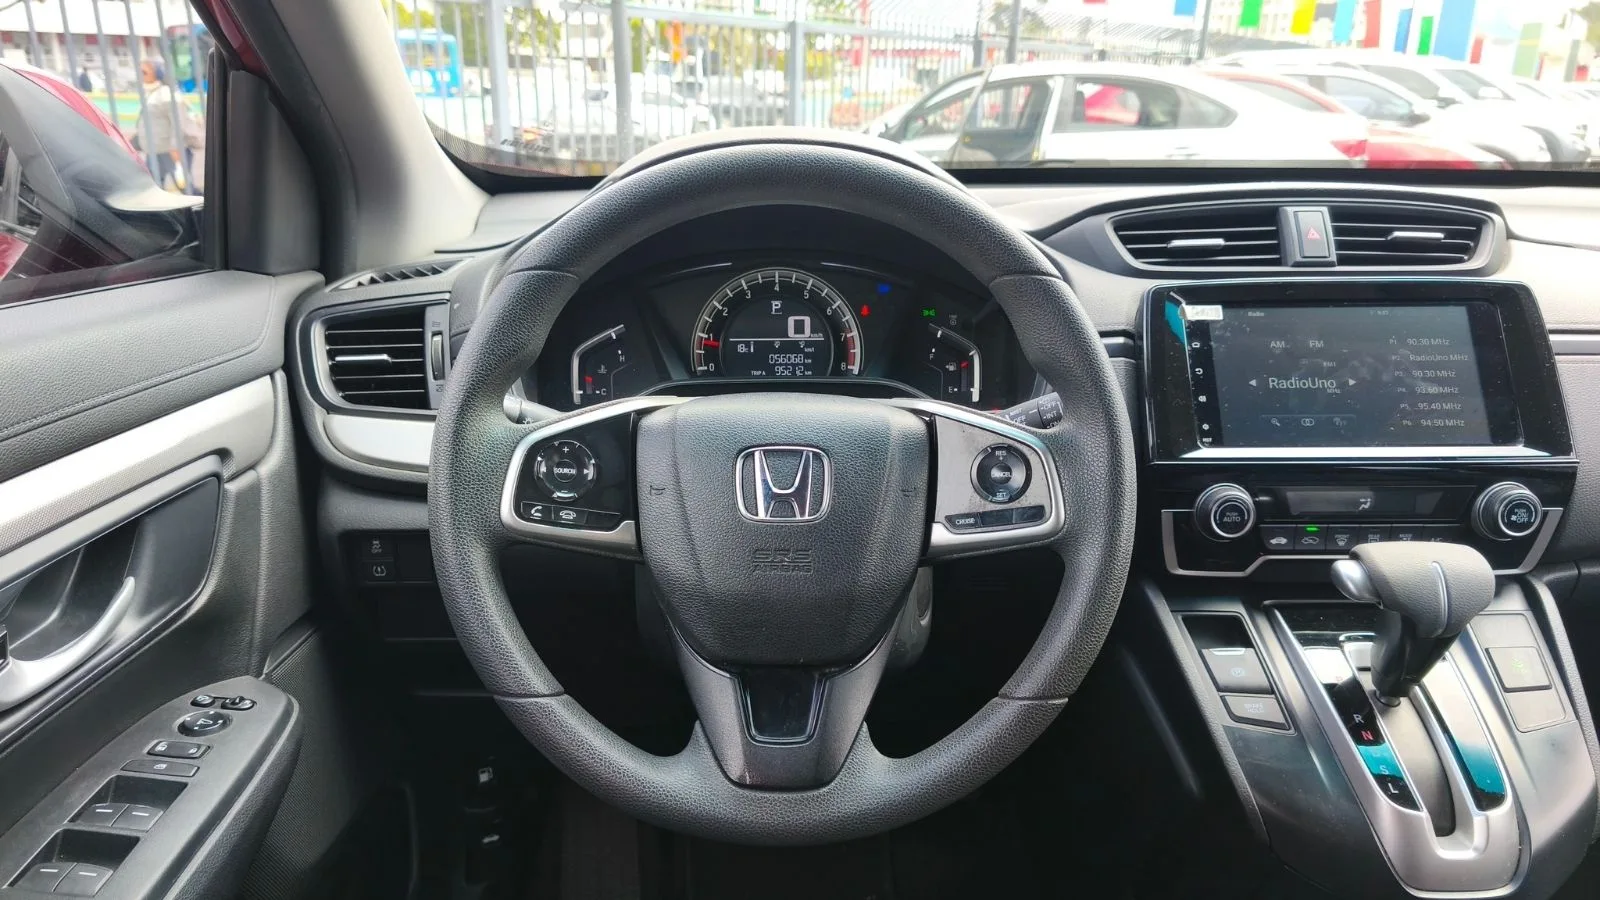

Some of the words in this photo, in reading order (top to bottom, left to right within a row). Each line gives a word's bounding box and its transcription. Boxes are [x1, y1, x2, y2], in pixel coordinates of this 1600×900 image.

[774, 282, 780, 292] 4
[745, 290, 752, 299] 3
[803, 290, 810, 299] 5
[722, 307, 729, 316] 2
[826, 306, 833, 316] 6
[787, 316, 811, 338] 0
[840, 333, 846, 342] 7
[1407, 338, 1430, 346] 90.30
[1270, 340, 1286, 348] AM
[1309, 340, 1324, 348] FM
[708, 363, 715, 371] 0
[840, 362, 847, 371] 8
[1411, 370, 1435, 378] 90.30
[1268, 376, 1337, 389] RadioUno
[600, 388, 607, 396] C
[1420, 419, 1444, 427] 94.50
[1352, 713, 1365, 724] R
[1361, 730, 1374, 741] N
[1380, 764, 1389, 775] S
[1387, 783, 1399, 794] L
